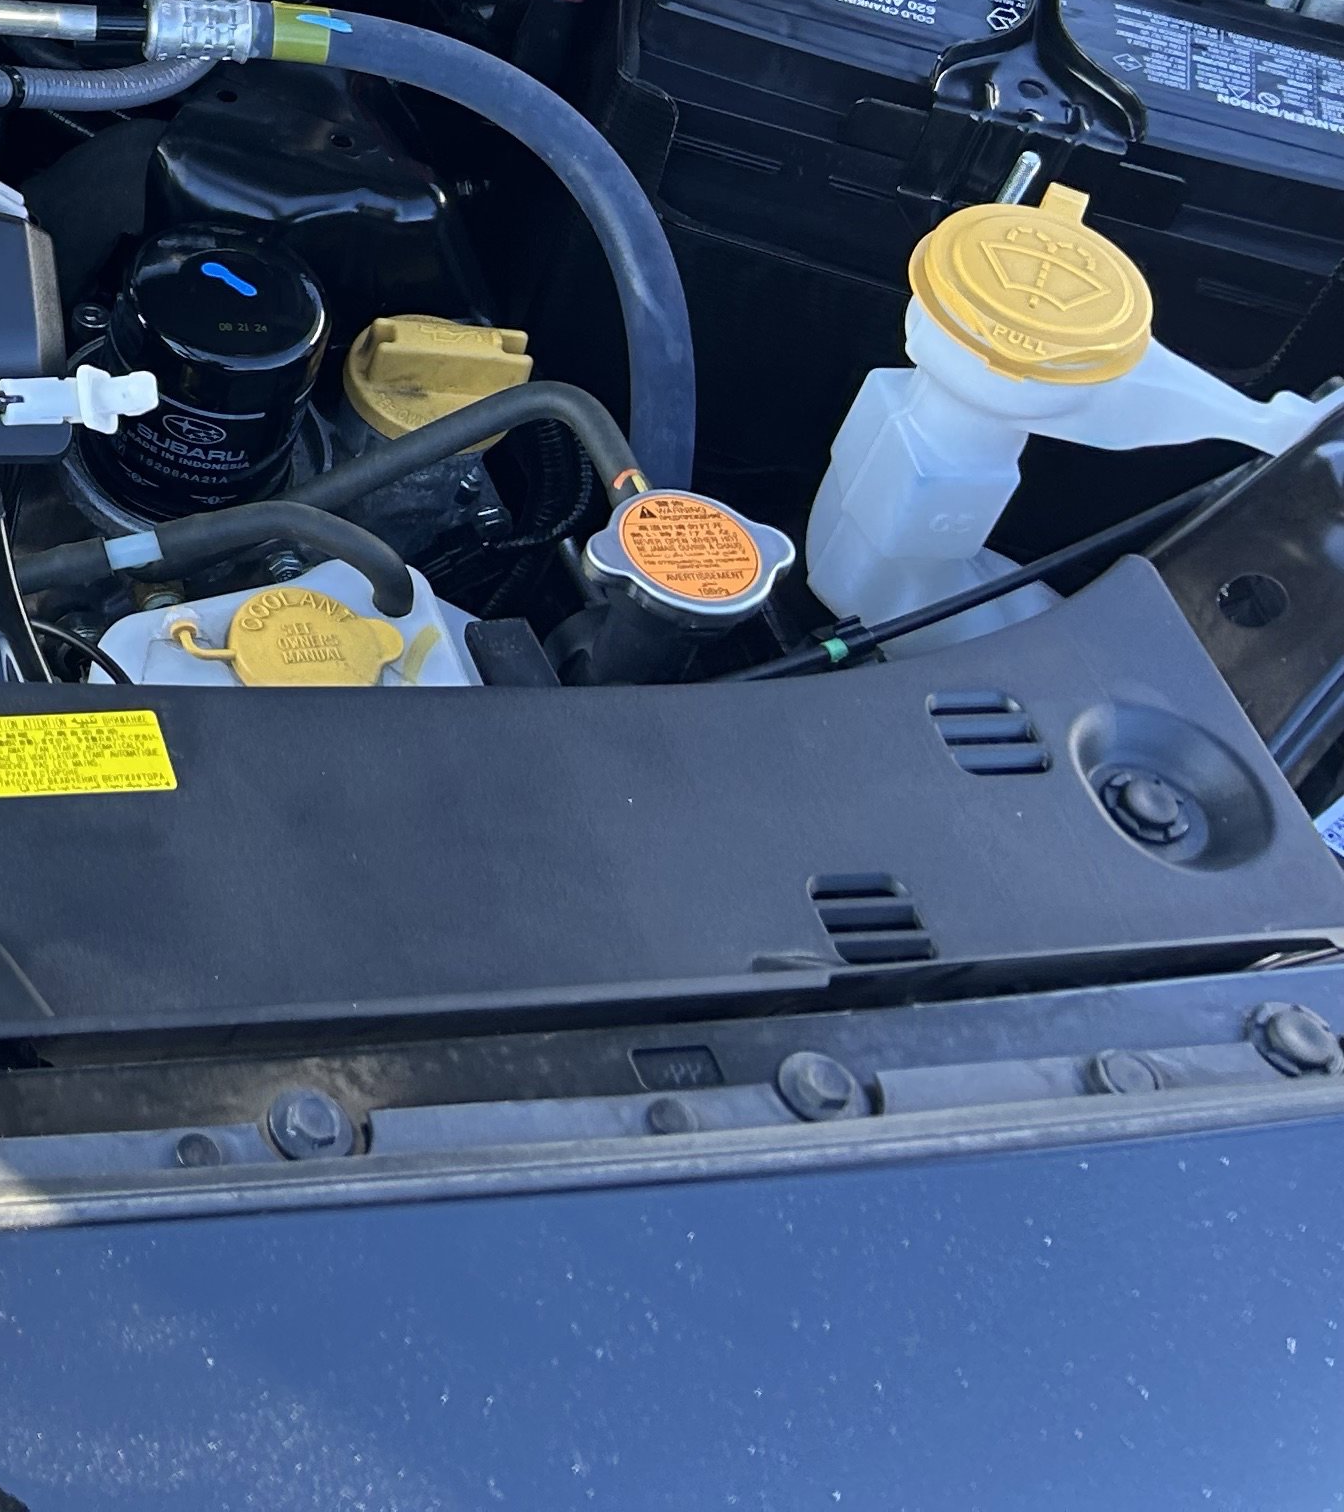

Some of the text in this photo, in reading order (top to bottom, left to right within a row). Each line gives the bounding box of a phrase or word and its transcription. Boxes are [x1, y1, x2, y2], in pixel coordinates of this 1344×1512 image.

[907, 0, 936, 15] 620
[900, 10, 935, 25] COLD
[992, 322, 1047, 356] PULL
[126, 428, 159, 452] MADE
[160, 450, 175, 461] IN
[178, 457, 250, 472] INDONESIA
[137, 422, 245, 462] SUBARU
[666, 570, 745, 582] AVERTISSEMENT
[240, 590, 357, 631] COOLANT
[280, 622, 313, 636] SEE
[281, 646, 344, 664] MANUAL
[22, 717, 67, 731] ATTENTION
